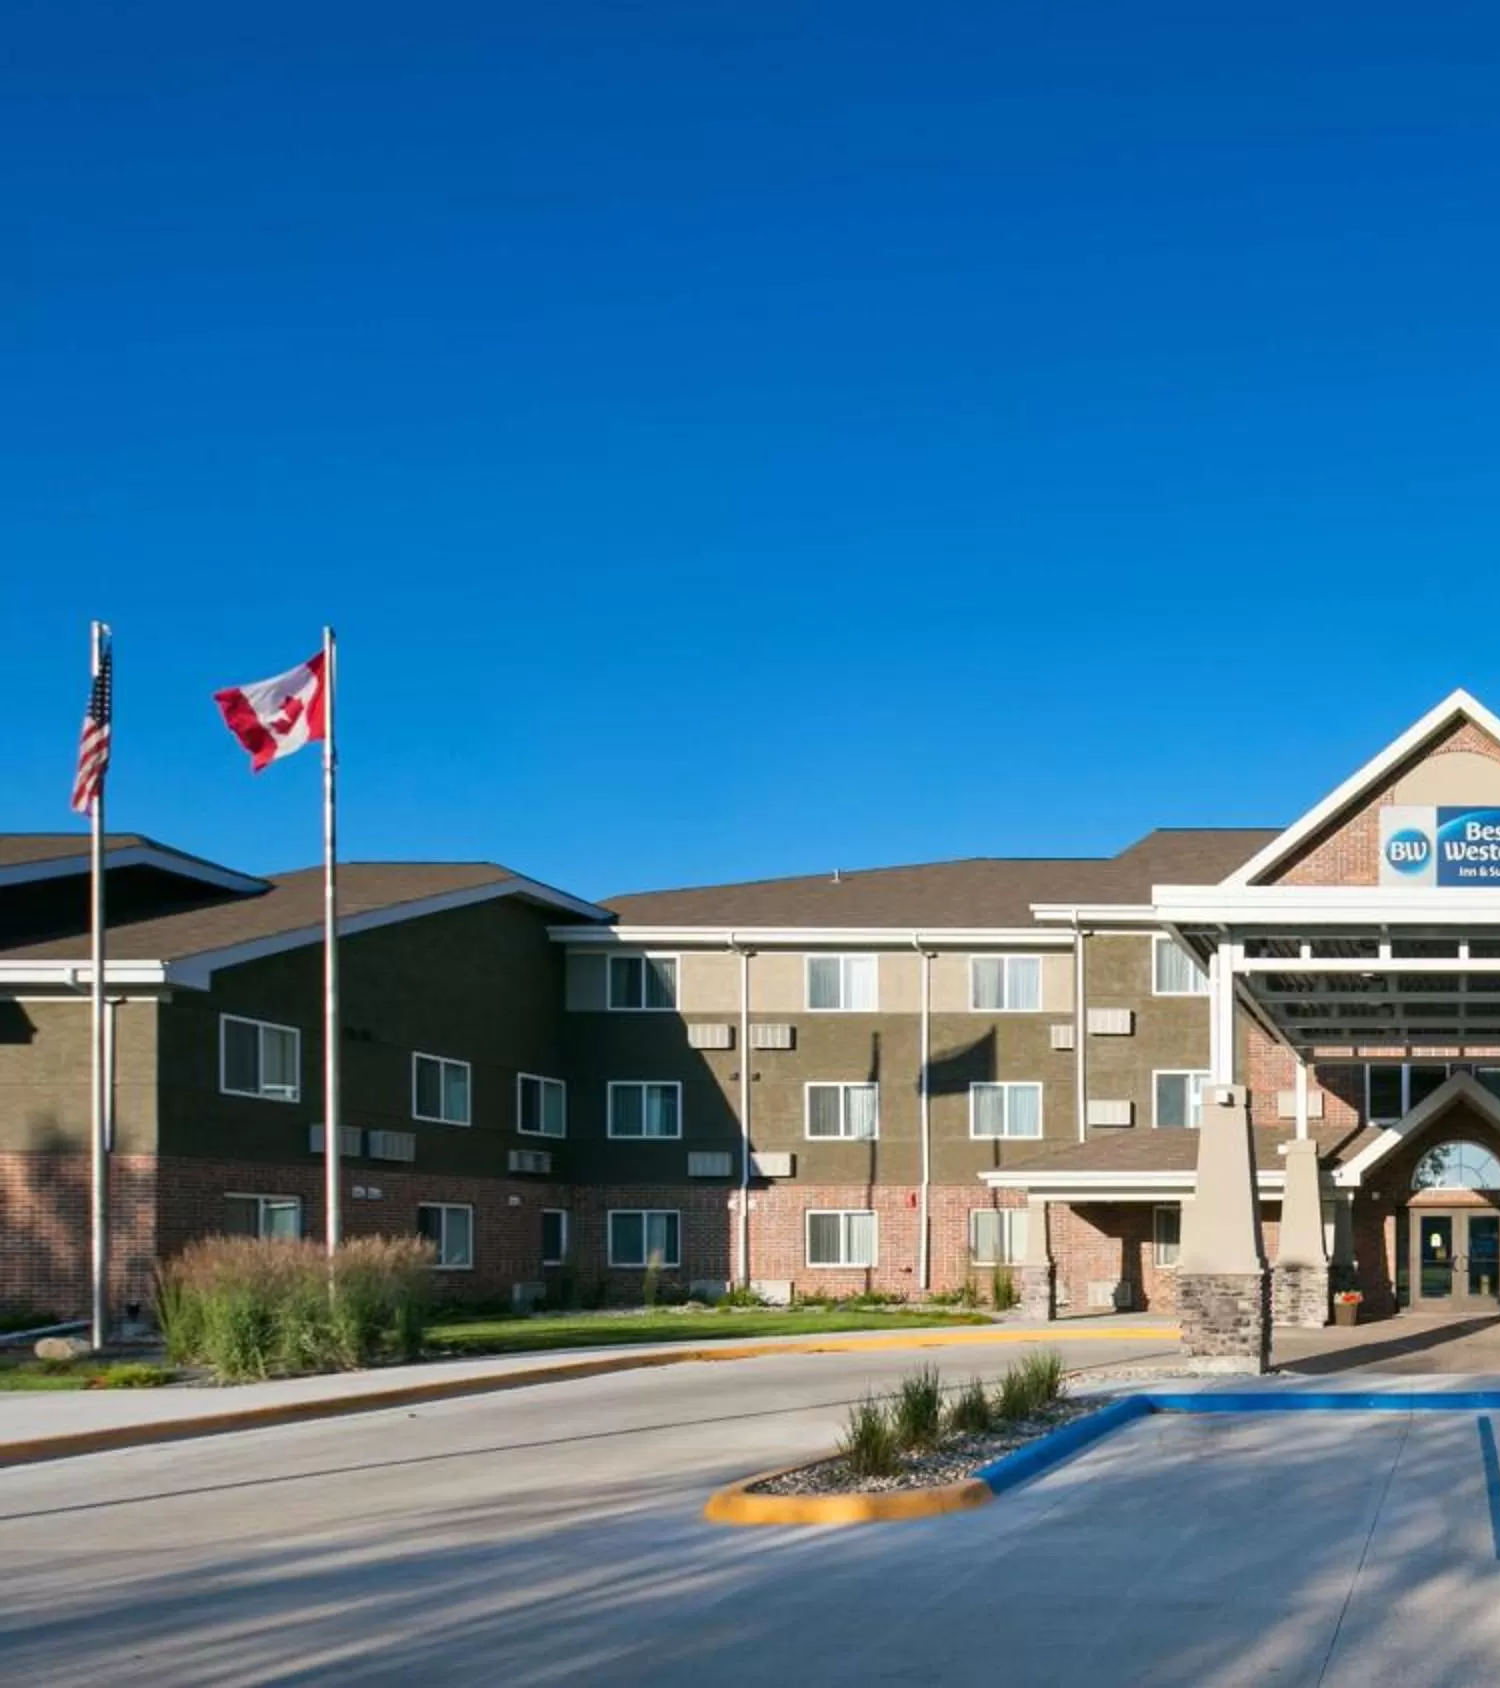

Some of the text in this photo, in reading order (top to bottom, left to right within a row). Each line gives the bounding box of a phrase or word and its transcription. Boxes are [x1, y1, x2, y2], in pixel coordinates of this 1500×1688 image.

[1390, 841, 1427, 862] BW
[1458, 865, 1477, 877] Inn
[1480, 865, 1488, 877] &
